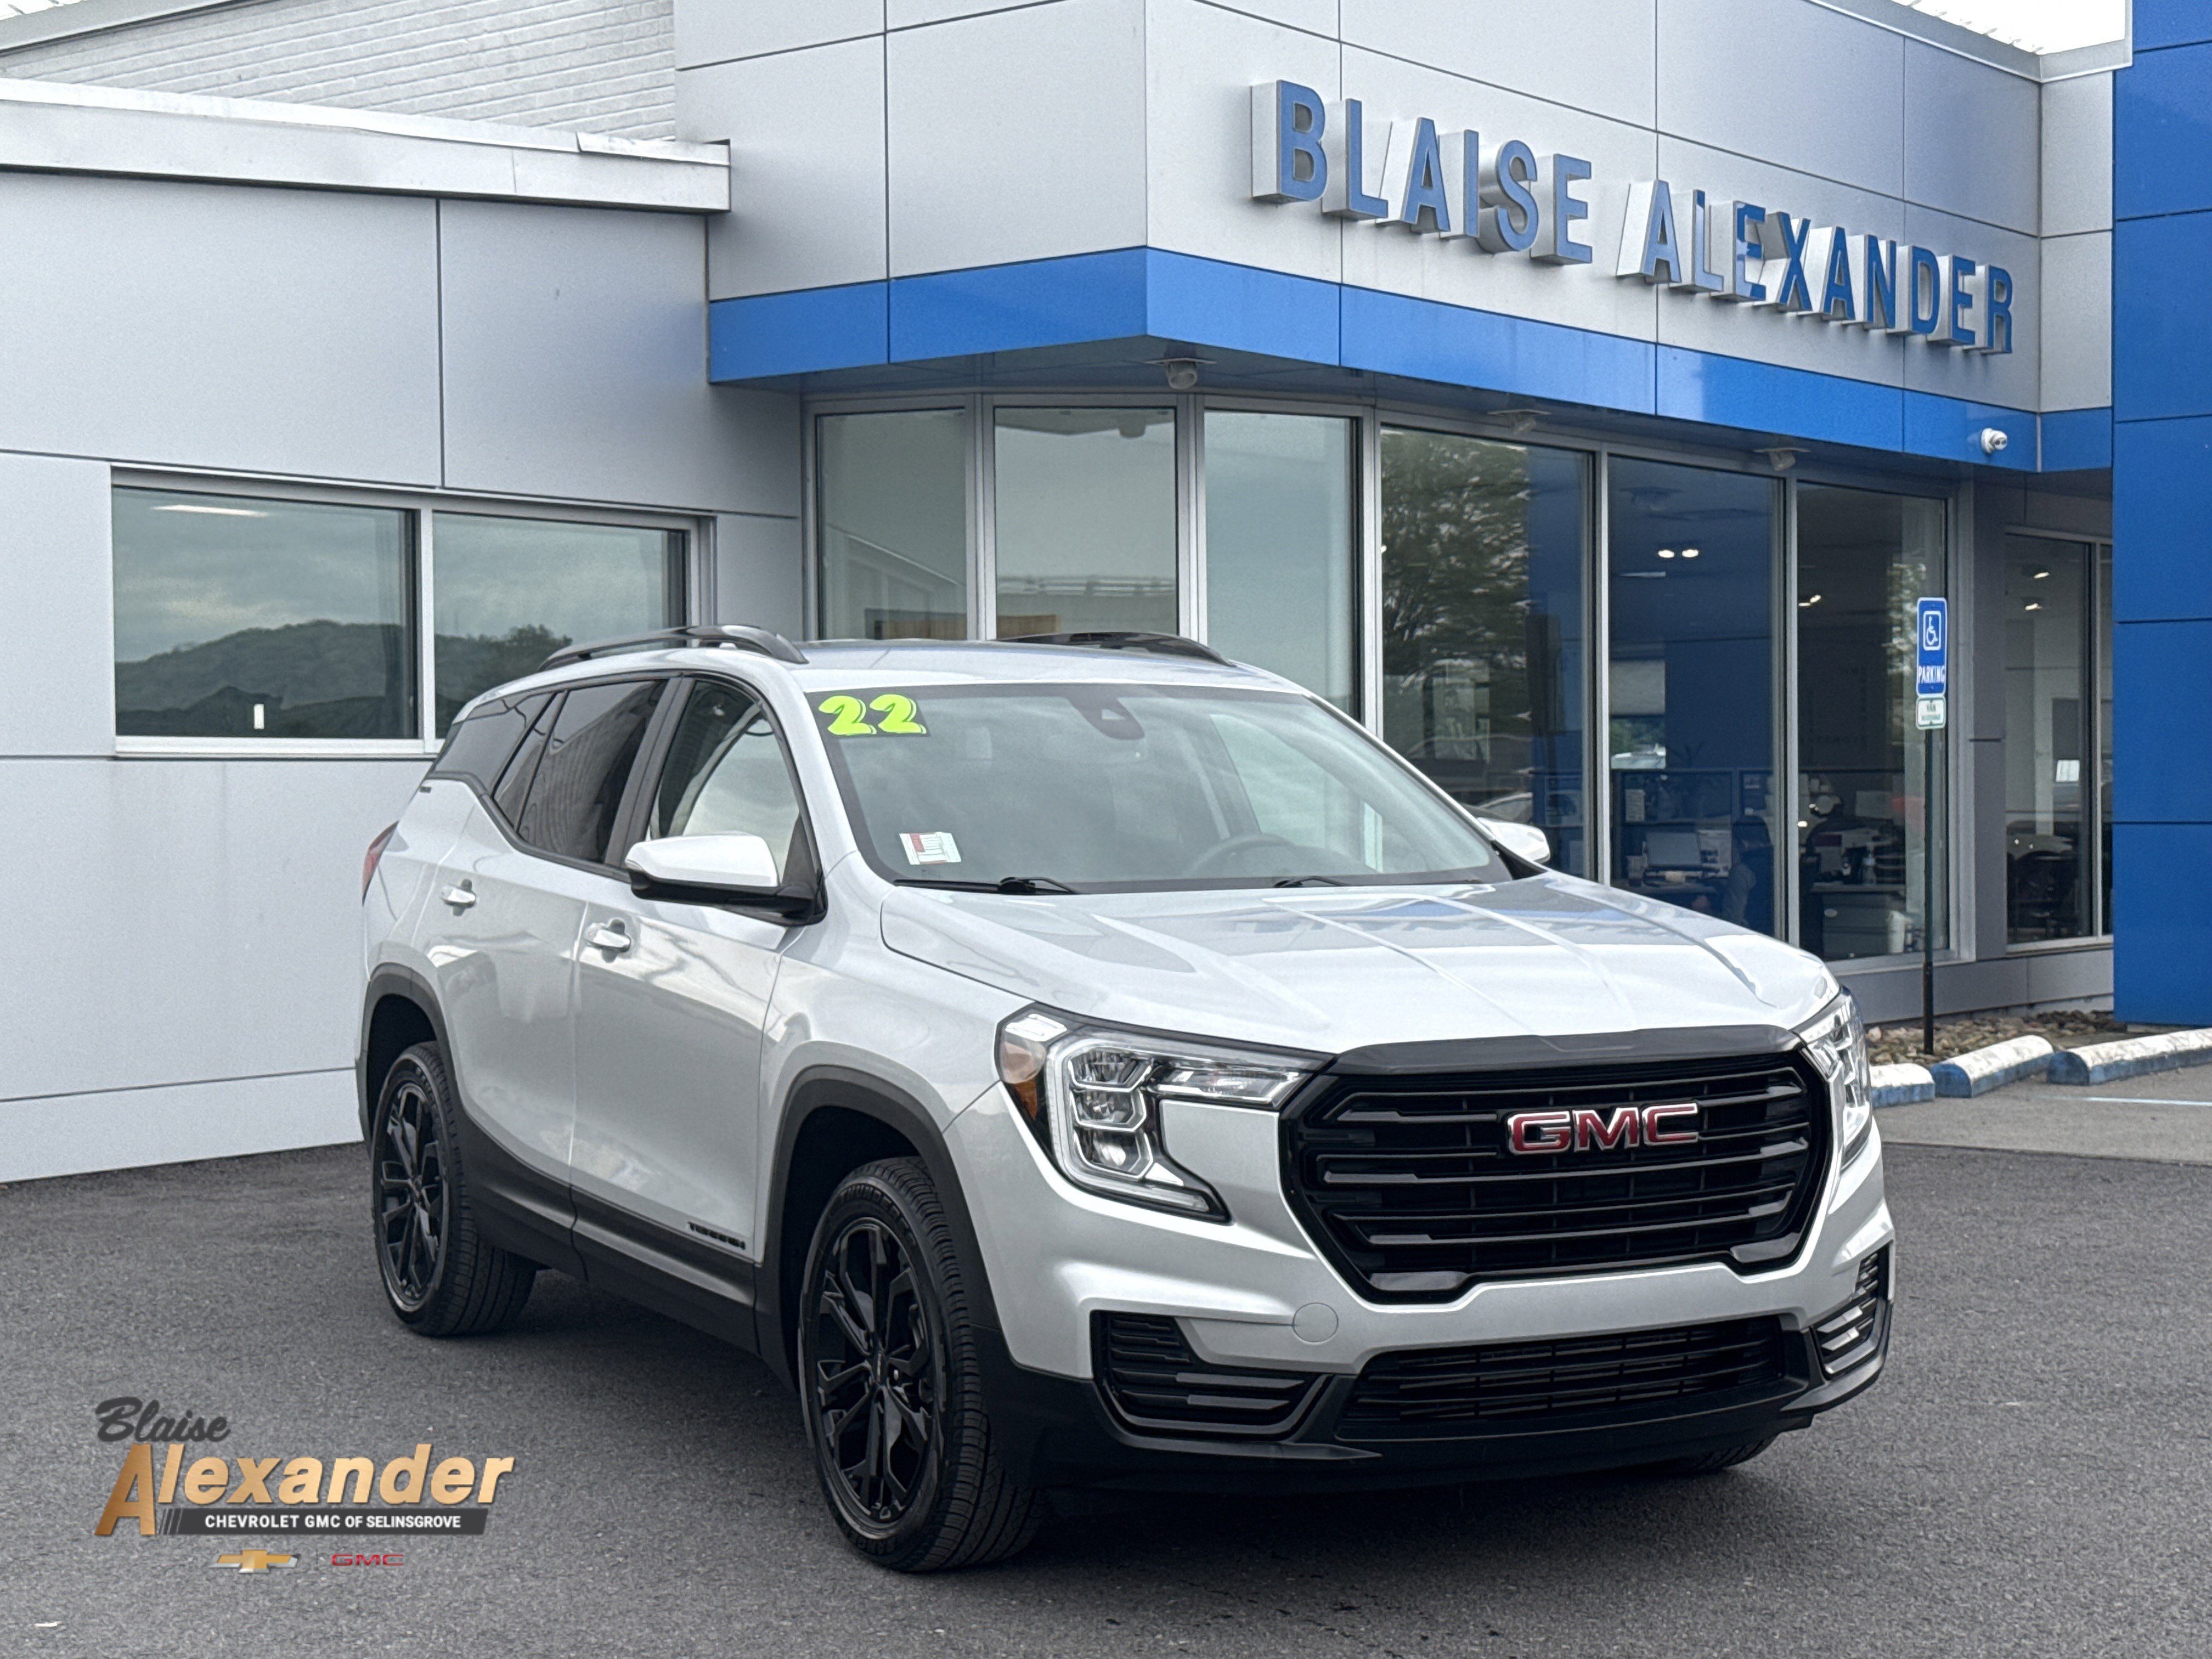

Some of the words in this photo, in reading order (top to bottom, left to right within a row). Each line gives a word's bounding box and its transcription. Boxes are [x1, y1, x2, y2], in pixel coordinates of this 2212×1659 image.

[1276, 79, 1593, 264] BLAISE
[1644, 179, 2013, 354] ALEXANDER
[1918, 665, 1945, 684] PARKING
[818, 693, 927, 736] 22
[1506, 1103, 1699, 1154] GMC
